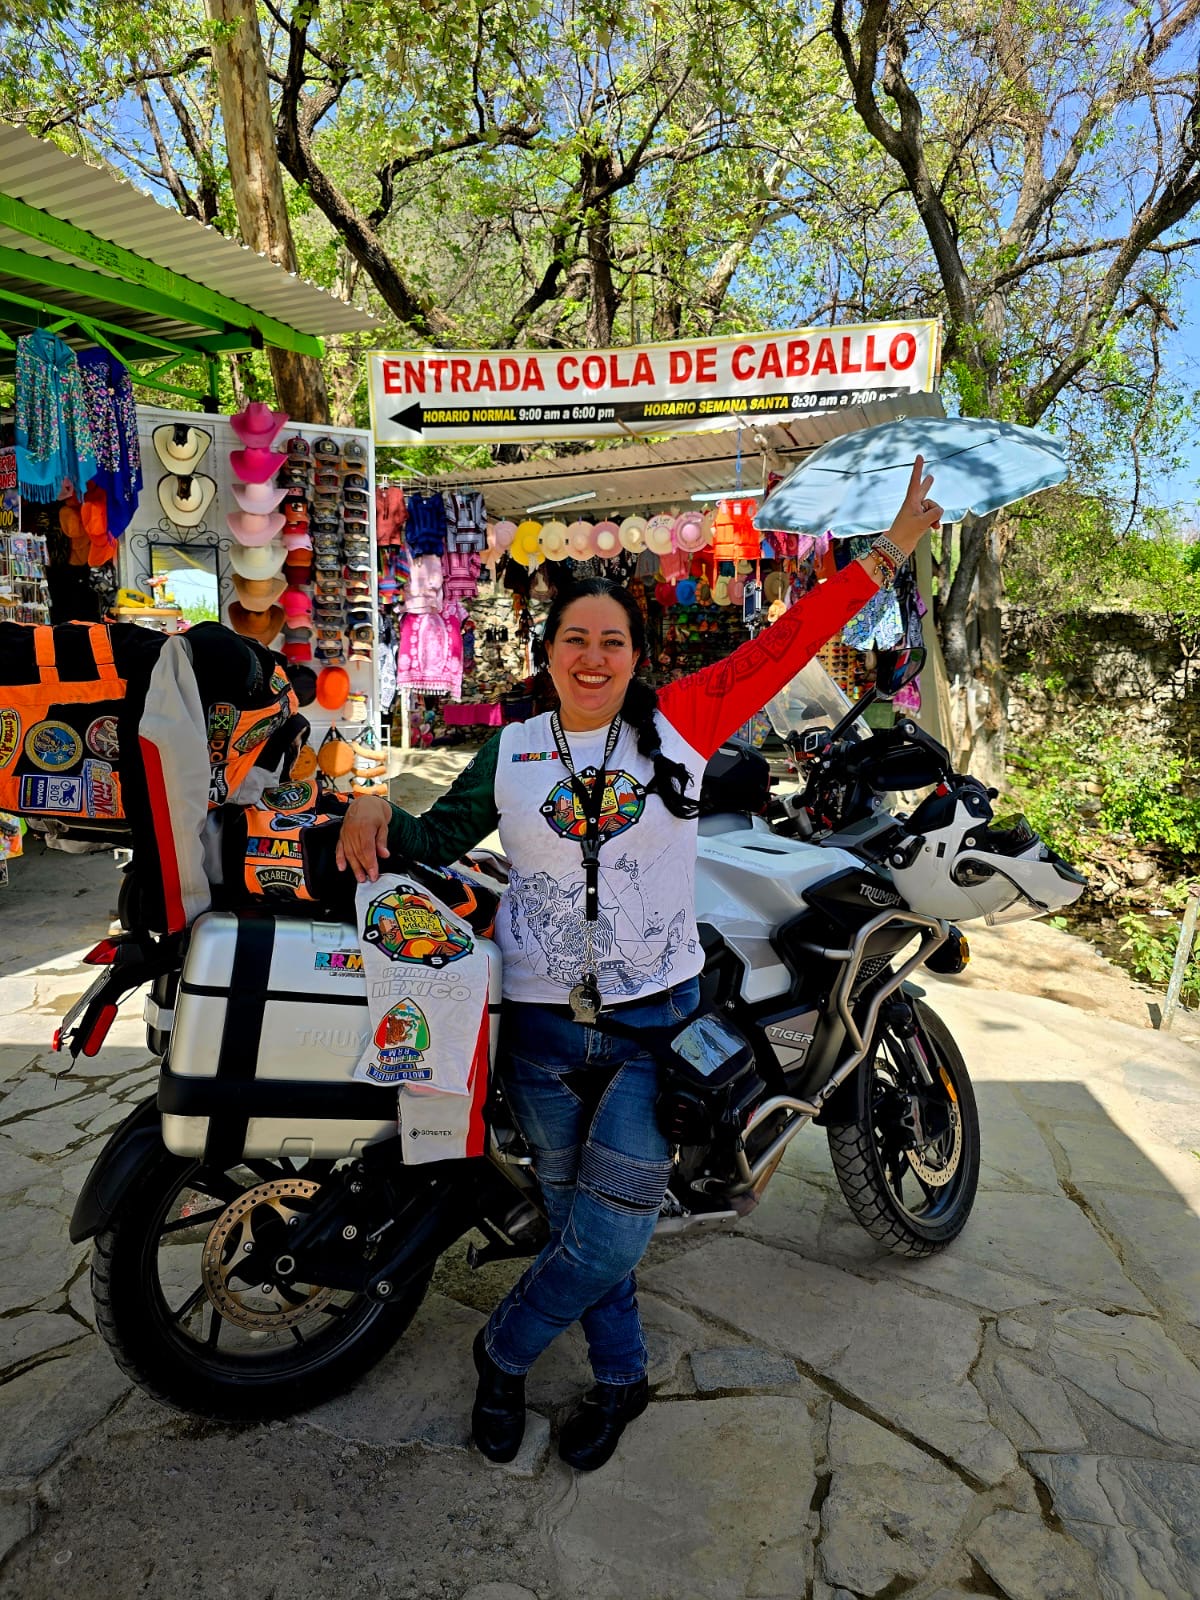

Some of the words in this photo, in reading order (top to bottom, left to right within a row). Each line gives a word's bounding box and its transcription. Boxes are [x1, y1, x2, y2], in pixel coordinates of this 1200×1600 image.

[383, 357, 545, 394] ENTRADA
[557, 353, 656, 391] COLA
[669, 347, 717, 384] DE
[731, 332, 917, 381] CABALLO
[643, 401, 696, 417] HORARIO
[698, 399, 747, 414] SEMANA
[749, 396, 789, 410] SANTA
[791, 394, 817, 408] 8:30
[818, 395, 838, 407] am
[840, 395, 848, 405] a
[850, 391, 877, 405] 7:00
[423, 410, 470, 423] HORARIO
[472, 408, 516, 422] NORMAL
[519, 407, 541, 421] 9:00
[544, 410, 560, 420] am
[563, 410, 569, 420] a
[572, 406, 596, 419] 6:00
[598, 407, 615, 421] pm
[260, 870, 299, 886] ARABELLA
[401, 886, 414, 894] N
[858, 883, 901, 906] TRIUMPH
[315, 951, 365, 970] RRM
[430, 956, 443, 965] S
[770, 1026, 814, 1044] TIGER
